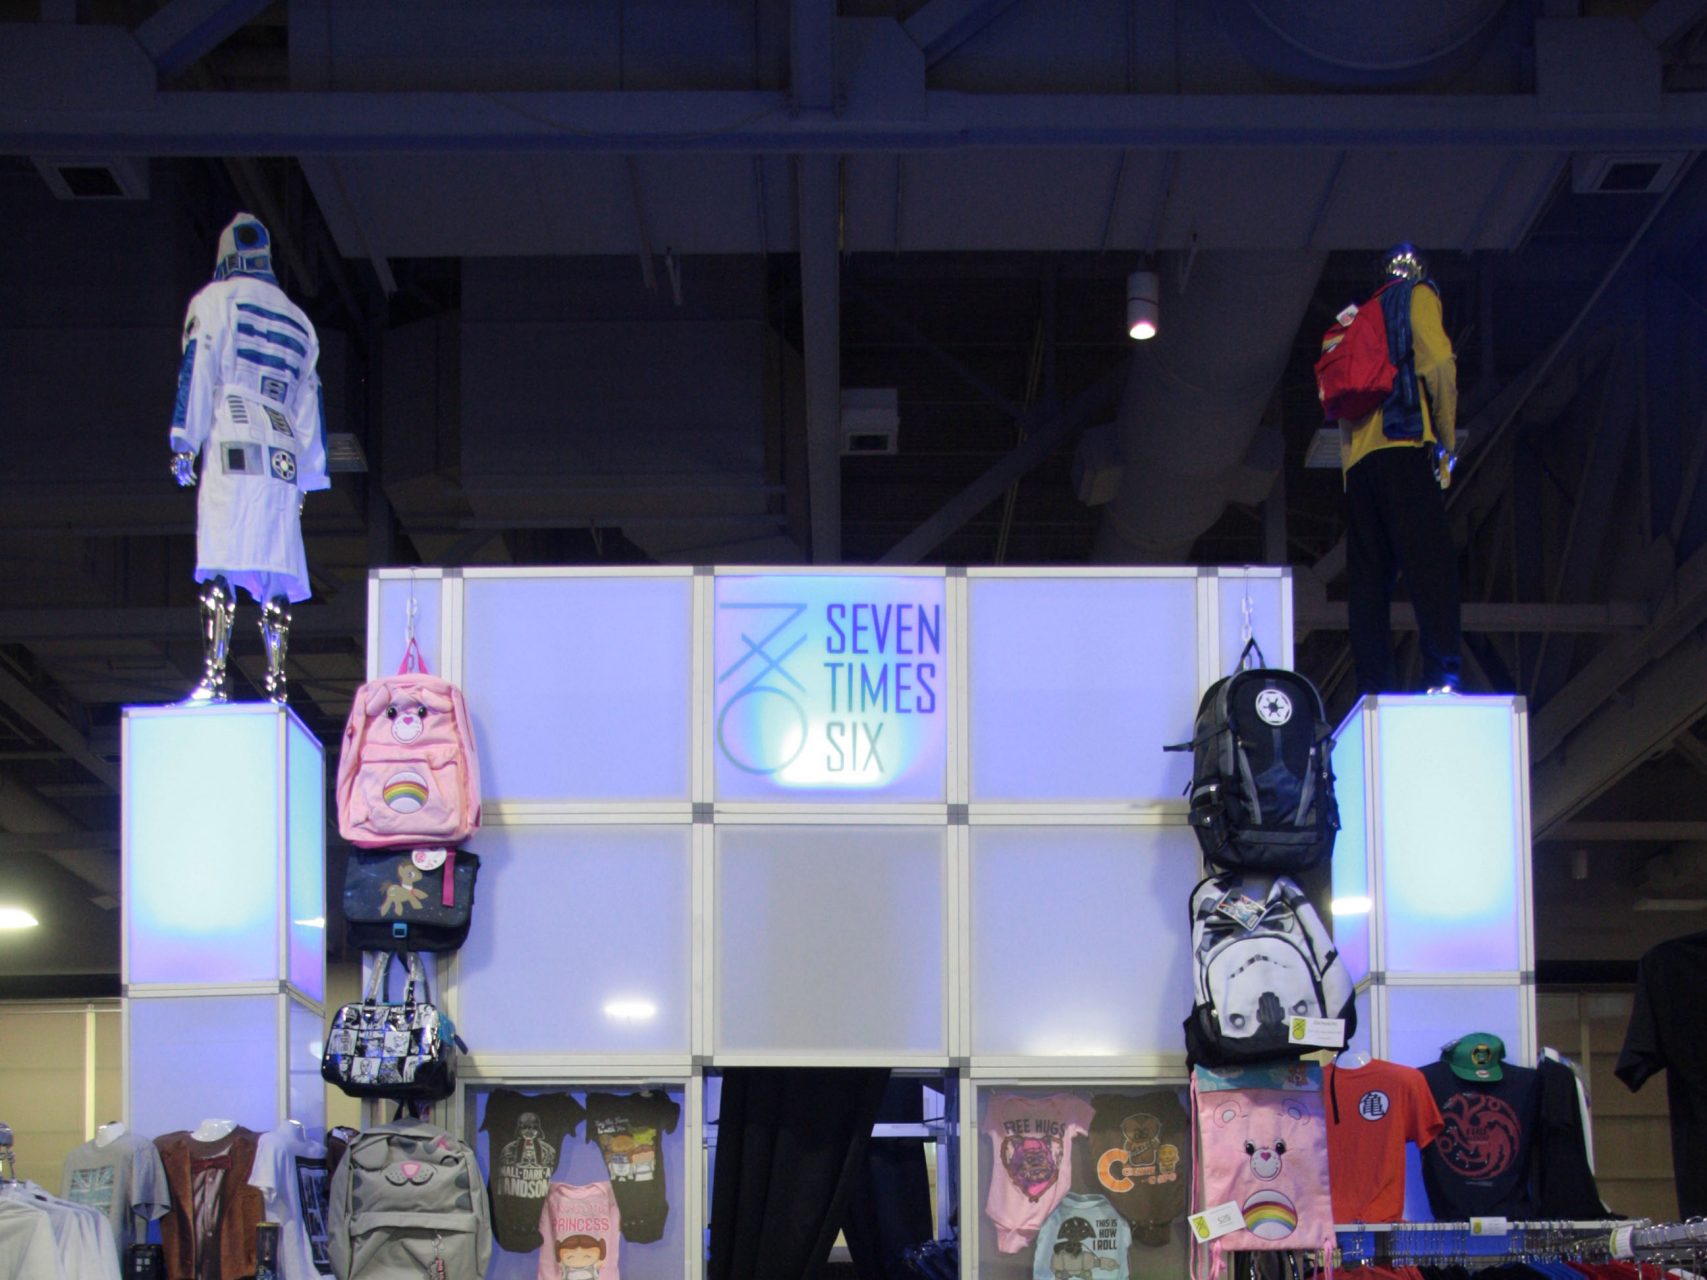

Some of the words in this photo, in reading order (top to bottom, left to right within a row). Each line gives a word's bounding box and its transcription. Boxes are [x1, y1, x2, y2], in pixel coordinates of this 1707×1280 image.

[826, 603, 941, 655] SEVEN
[824, 662, 936, 714] TIMES
[826, 721, 885, 773] SIX
[1003, 1118, 1031, 1134] FREE
[1036, 1119, 1066, 1136] HUGS
[1096, 1219, 1109, 1228] THIS
[1111, 1218, 1118, 1227] IS
[1099, 1228, 1117, 1238] HOW
[1097, 1240, 1117, 1250] ROLL
